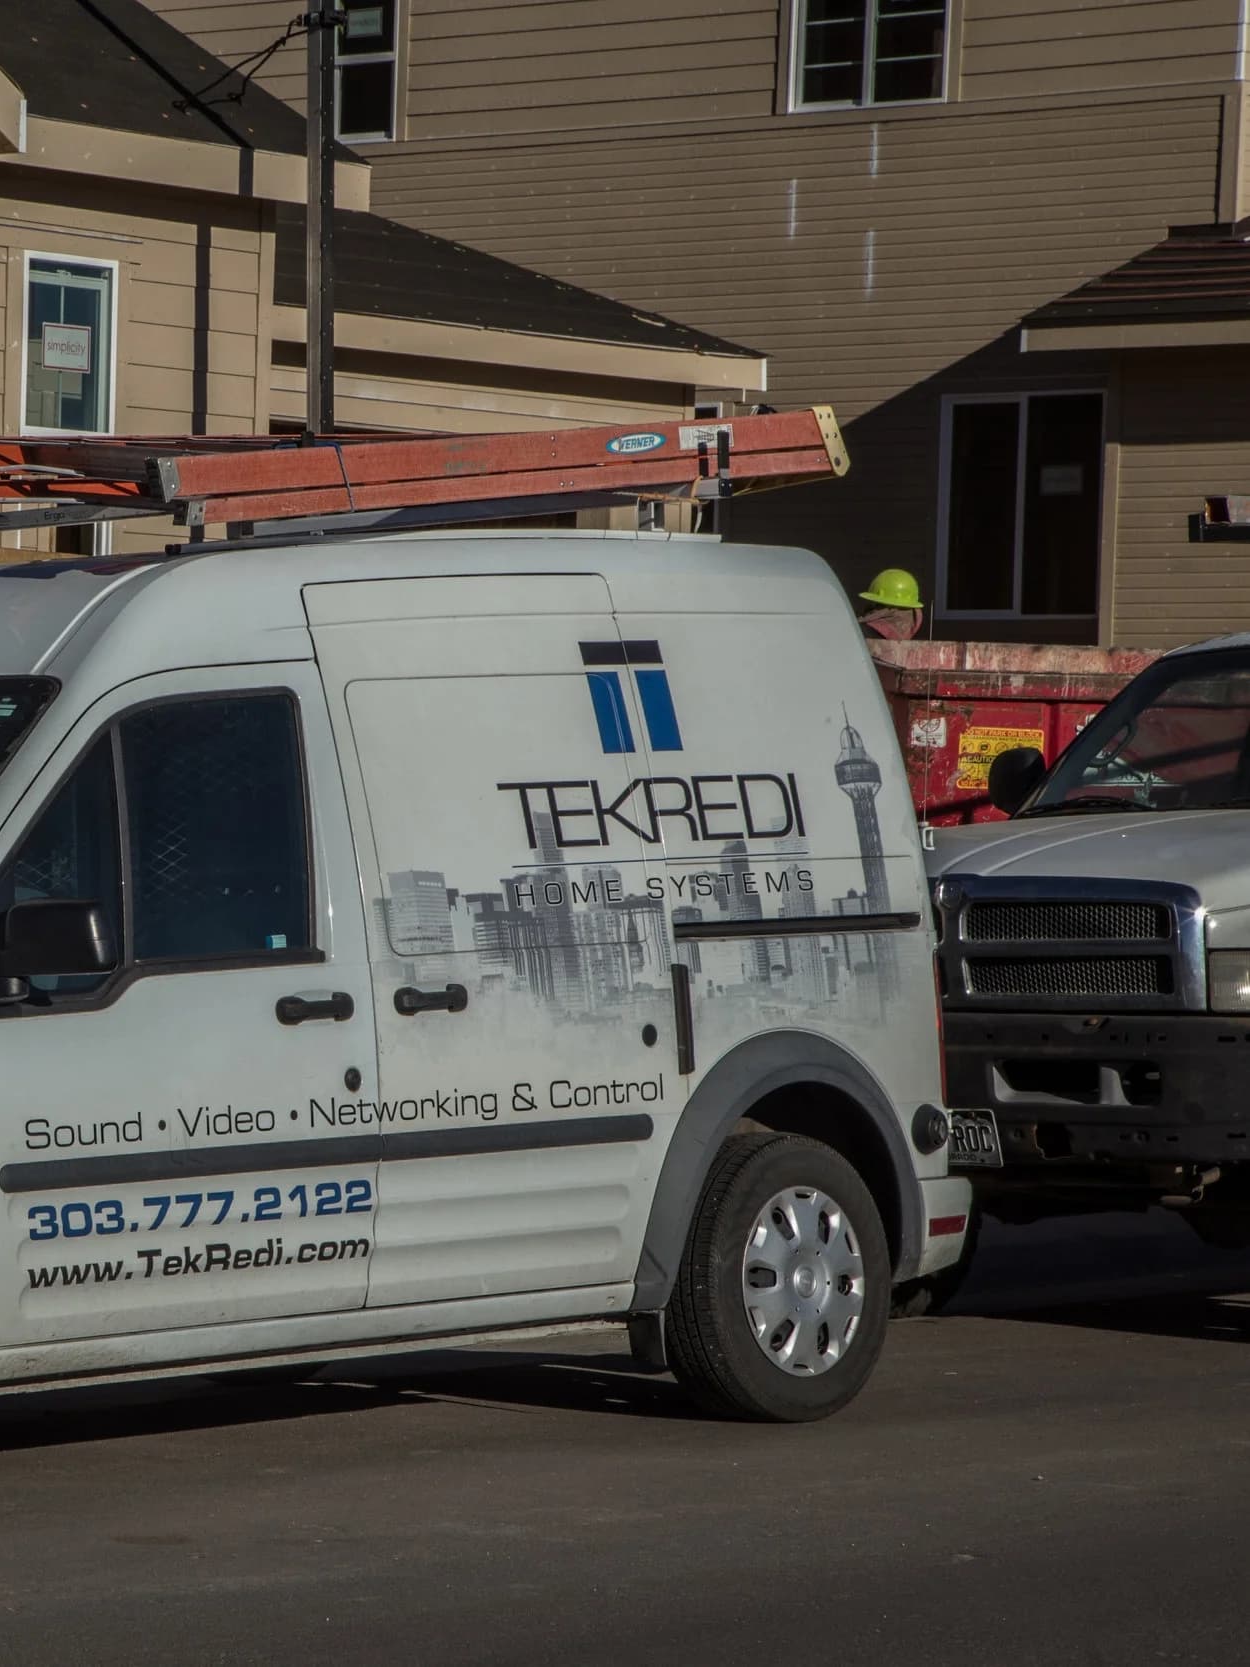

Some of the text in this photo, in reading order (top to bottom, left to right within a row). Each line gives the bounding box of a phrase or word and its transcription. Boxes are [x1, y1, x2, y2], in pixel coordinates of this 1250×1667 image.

[47, 337, 86, 357] simplicity
[967, 755, 996, 764] CAUTIO
[497, 773, 805, 848] TEKREDI
[515, 870, 814, 907] HOME SYSTEMS
[25, 1073, 664, 1150] Sound Video Networking & Control
[28, 1179, 373, 1241] 303.777.2122
[27, 1237, 370, 1289] www.TekRedi.com
